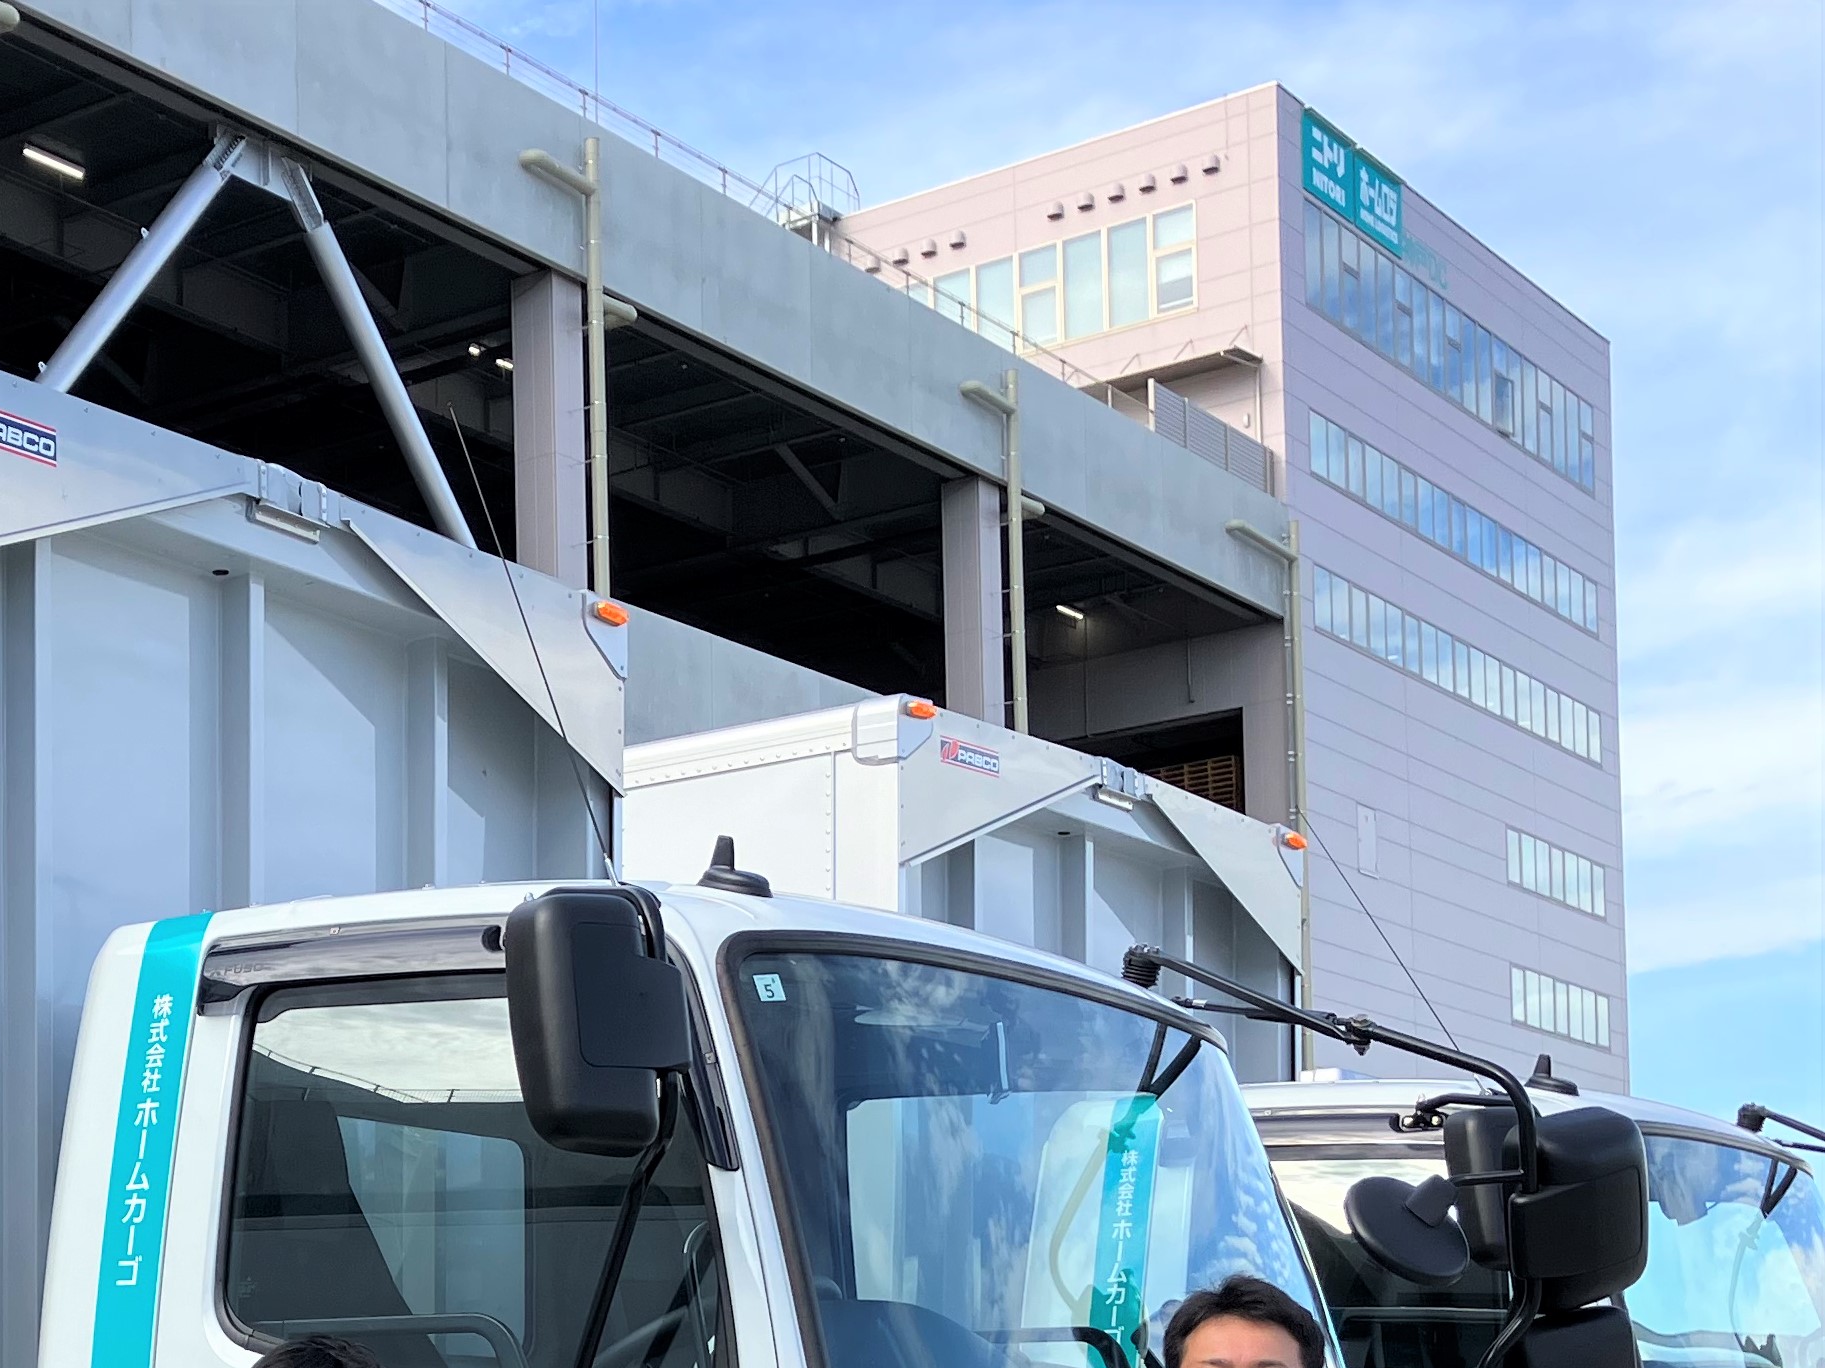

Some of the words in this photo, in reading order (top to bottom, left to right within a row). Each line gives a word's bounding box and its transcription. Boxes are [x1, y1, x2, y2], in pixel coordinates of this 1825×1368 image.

[1311, 125, 1346, 179] ニトリ
[958, 750, 1000, 772] PABCO
[763, 983, 775, 999] 5
[115, 993, 174, 1287] 株式会社ホームカーゴ
